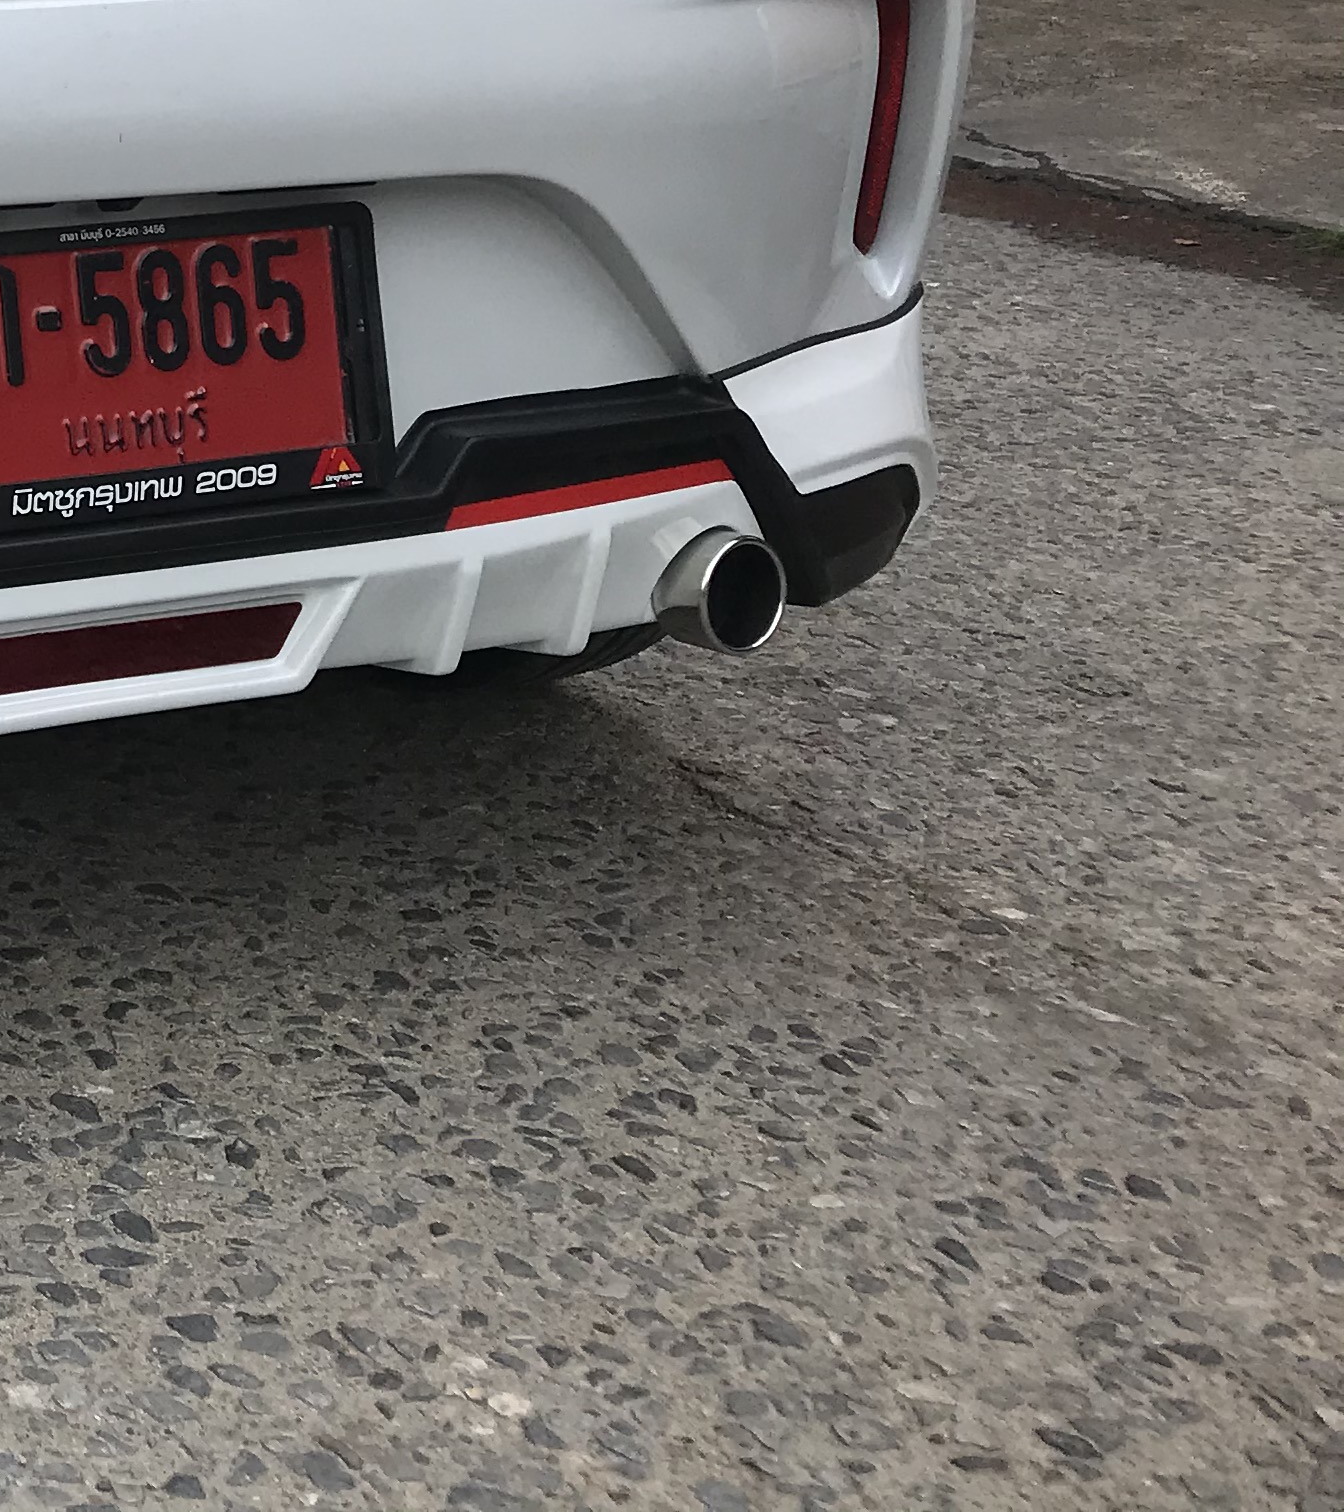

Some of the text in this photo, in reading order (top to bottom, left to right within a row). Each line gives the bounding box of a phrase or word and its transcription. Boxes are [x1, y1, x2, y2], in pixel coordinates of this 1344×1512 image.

[142, 223, 166, 236] 3456
[62, 386, 208, 464] นนทบุรี
[12, 463, 278, 519] มิตซูกรุงเทพ 2009
